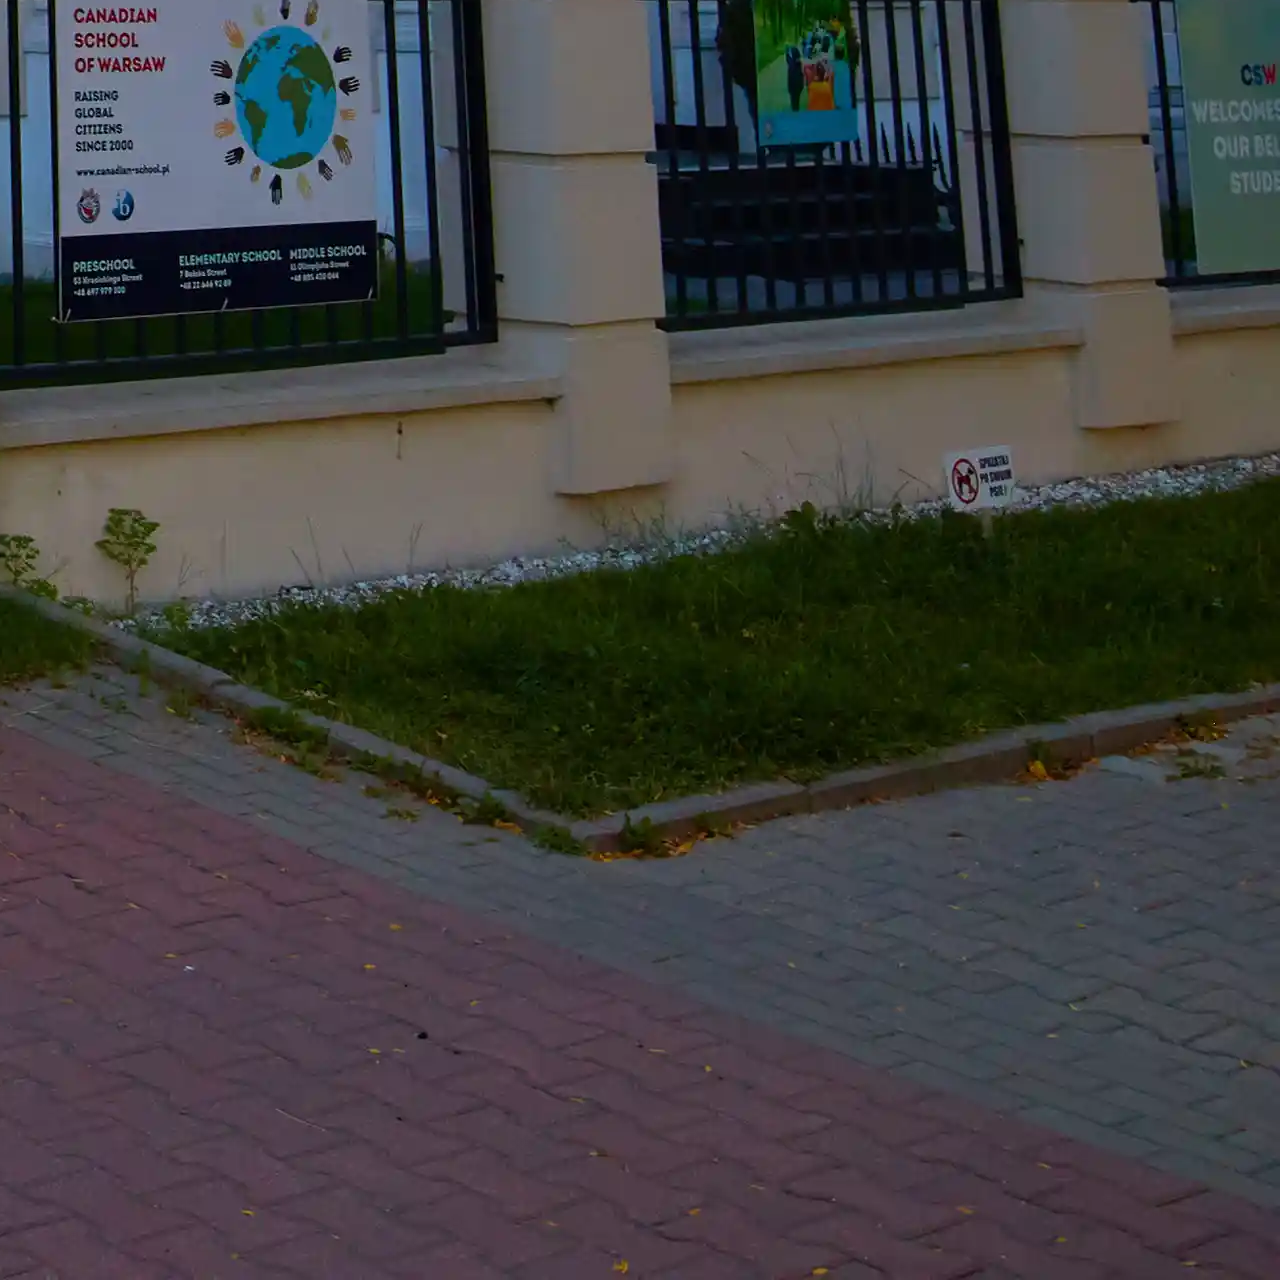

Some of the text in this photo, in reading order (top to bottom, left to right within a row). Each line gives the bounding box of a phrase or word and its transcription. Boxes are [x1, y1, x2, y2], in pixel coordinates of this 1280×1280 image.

[73, 8, 157, 23] CANADIAN
[74, 32, 138, 48] SCHOOL
[75, 56, 165, 73] OF WARSAW
[1241, 64, 1276, 86] CSW
[75, 91, 119, 102] RAISING
[75, 107, 114, 118] GLOBAL
[76, 124, 122, 135] CITIZENS
[76, 139, 134, 152] SINCE 2000
[1213, 135, 1249, 160] OUR
[76, 163, 170, 176] www.canadian-school.pl
[179, 249, 282, 266] ELEMENTARY SCHOOL
[290, 244, 367, 259] MIDDLE SCHOOL
[73, 258, 136, 273] PRESCHOOL
